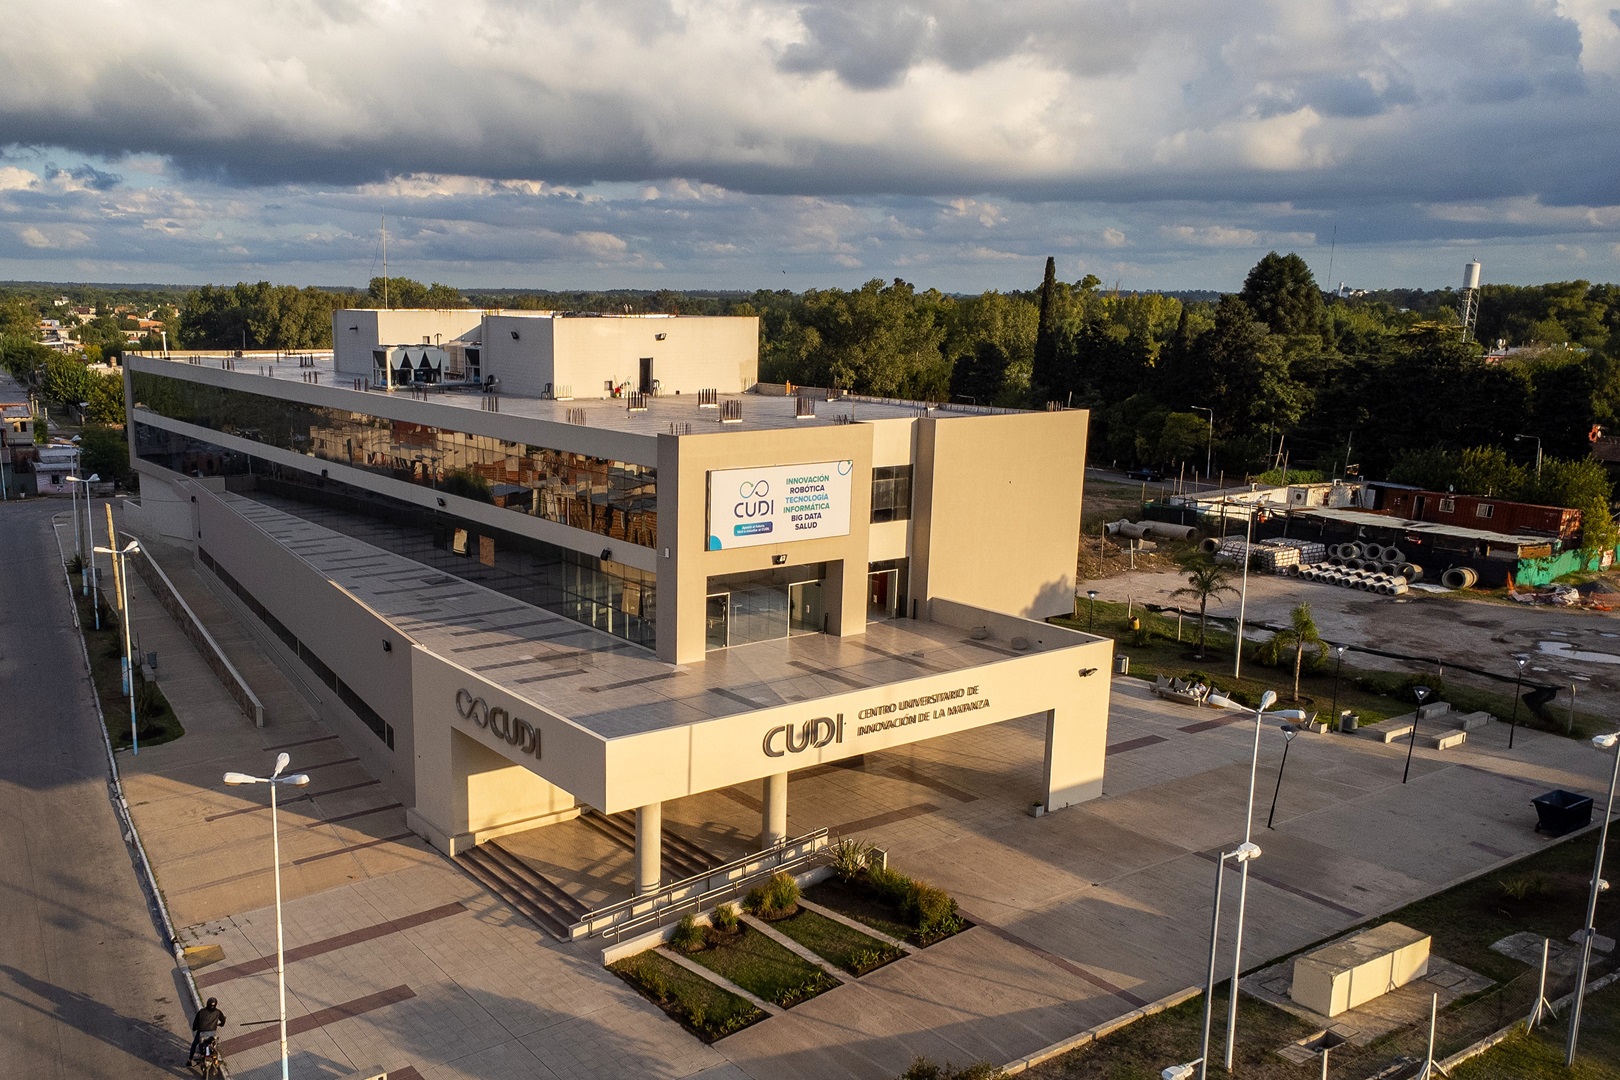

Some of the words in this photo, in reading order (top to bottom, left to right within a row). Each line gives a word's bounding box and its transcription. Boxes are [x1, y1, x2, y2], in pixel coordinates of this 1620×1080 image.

[785, 474, 830, 485] INNOVACIÓN
[789, 484, 825, 494] ROBÓTICA
[785, 492, 829, 504] TECNOLOGÍA
[733, 499, 774, 518] CUDI
[783, 502, 830, 514] INFORMÁTICA
[791, 514, 803, 522] BIG
[804, 512, 822, 521] DATA
[794, 521, 818, 531] SALUD
[857, 702, 897, 720] CENTRO
[898, 688, 965, 711] UNIVERSITARIO
[966, 685, 980, 696] DE
[856, 713, 917, 737] INNOVACIÓN
[917, 711, 931, 723] DE
[932, 708, 946, 720] LA
[946, 698, 991, 716] MATANZA
[489, 706, 542, 760] CUDI
[762, 713, 844, 758] CUDI
